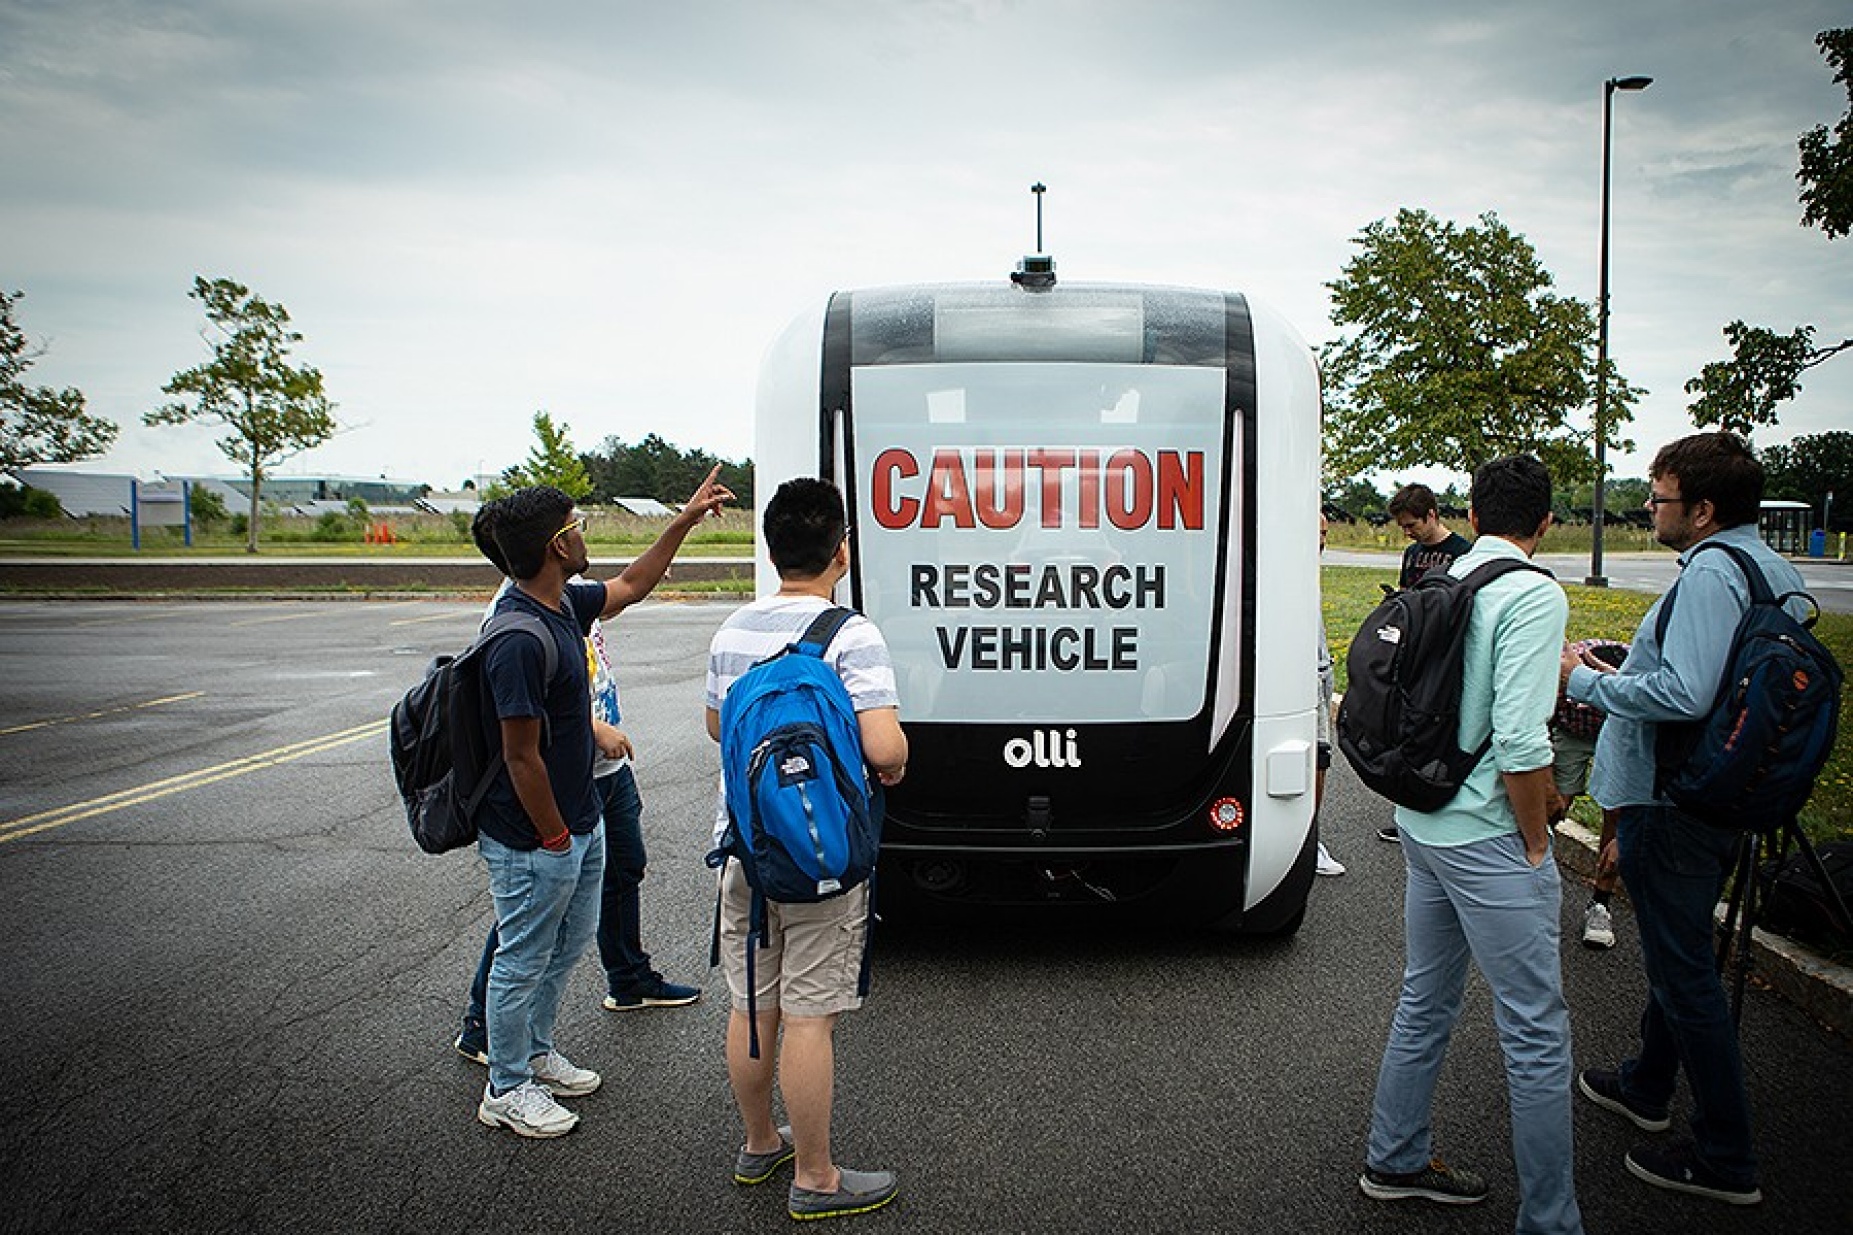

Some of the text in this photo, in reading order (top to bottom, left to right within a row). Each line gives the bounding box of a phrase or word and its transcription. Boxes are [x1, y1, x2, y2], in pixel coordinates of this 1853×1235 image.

[871, 448, 1205, 530] CAUTION
[911, 565, 1165, 609] RESEARCH
[936, 626, 1138, 671] VEHICLE
[1003, 729, 1081, 768] olli
